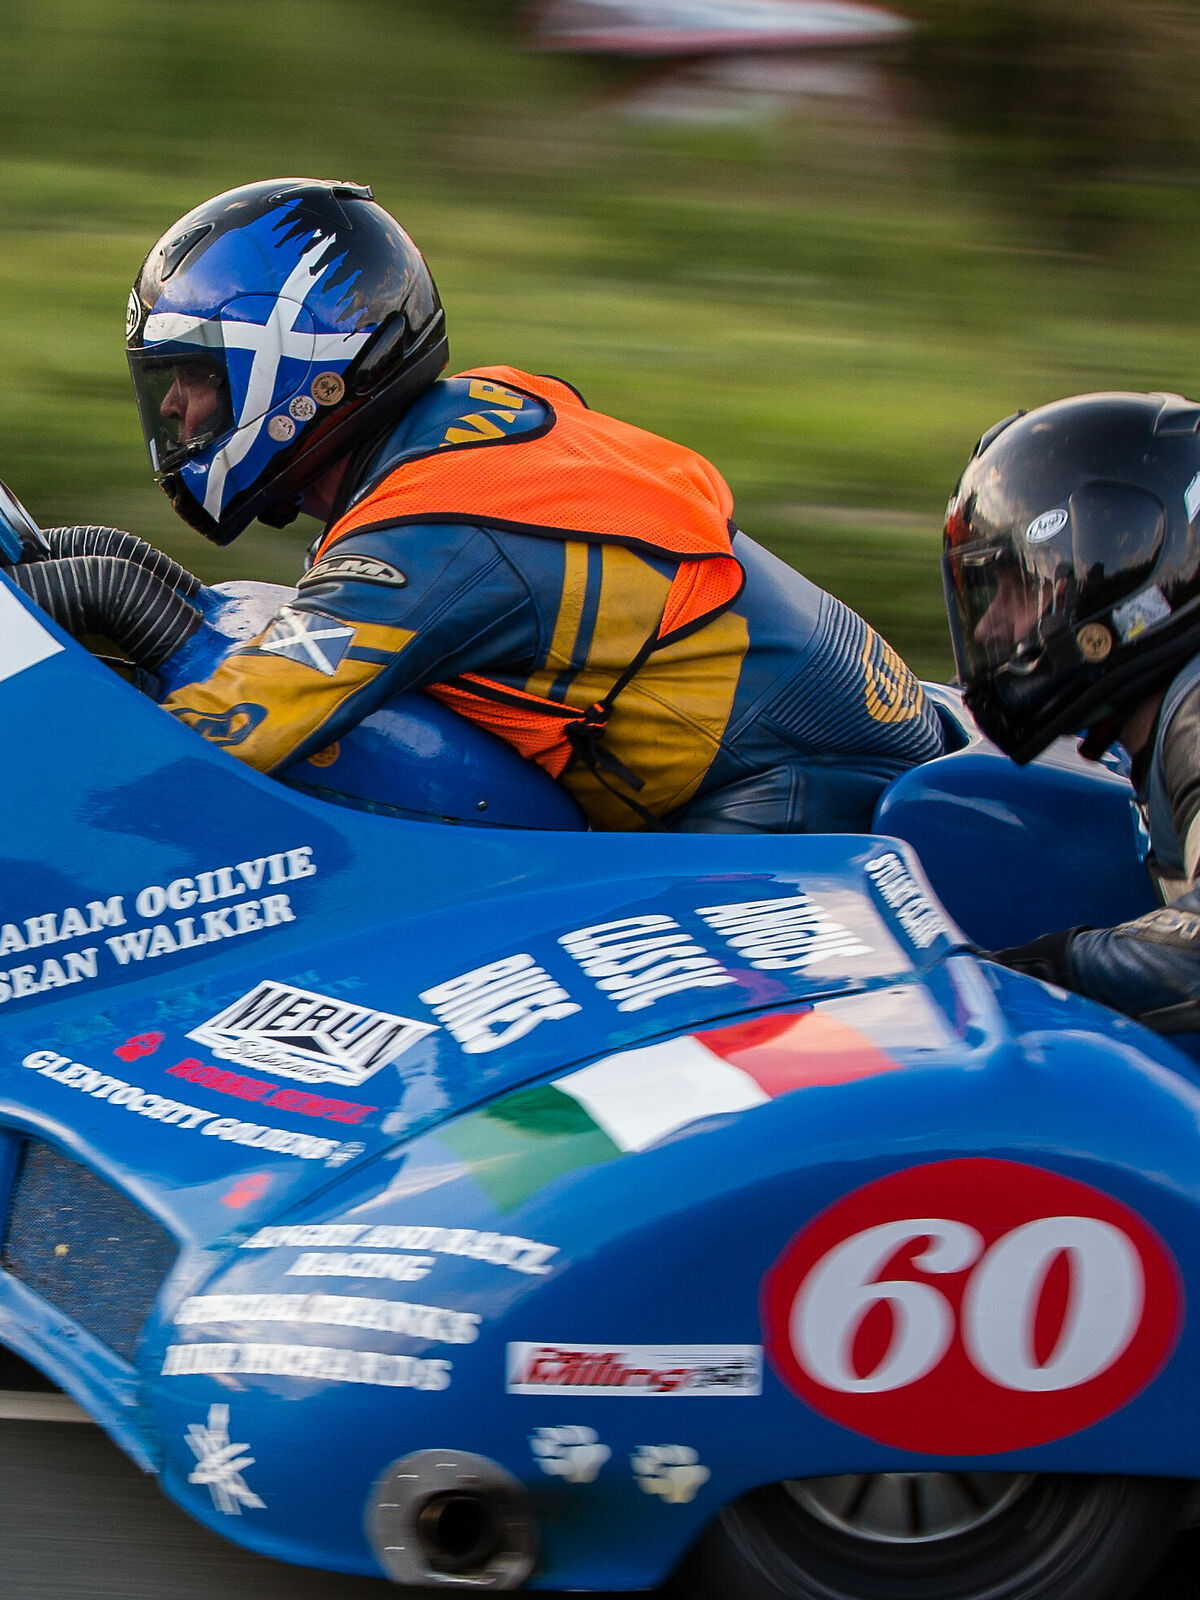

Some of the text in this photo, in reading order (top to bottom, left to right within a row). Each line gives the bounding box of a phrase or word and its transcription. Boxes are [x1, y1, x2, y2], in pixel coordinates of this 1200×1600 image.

[135, 846, 317, 918] OGILVIE
[105, 894, 296, 965] WALKER
[557, 914, 738, 1012] CLASSIC
[693, 894, 875, 970] ANGUS
[418, 953, 582, 1054] BIKES
[788, 1216, 1146, 1393] 60
